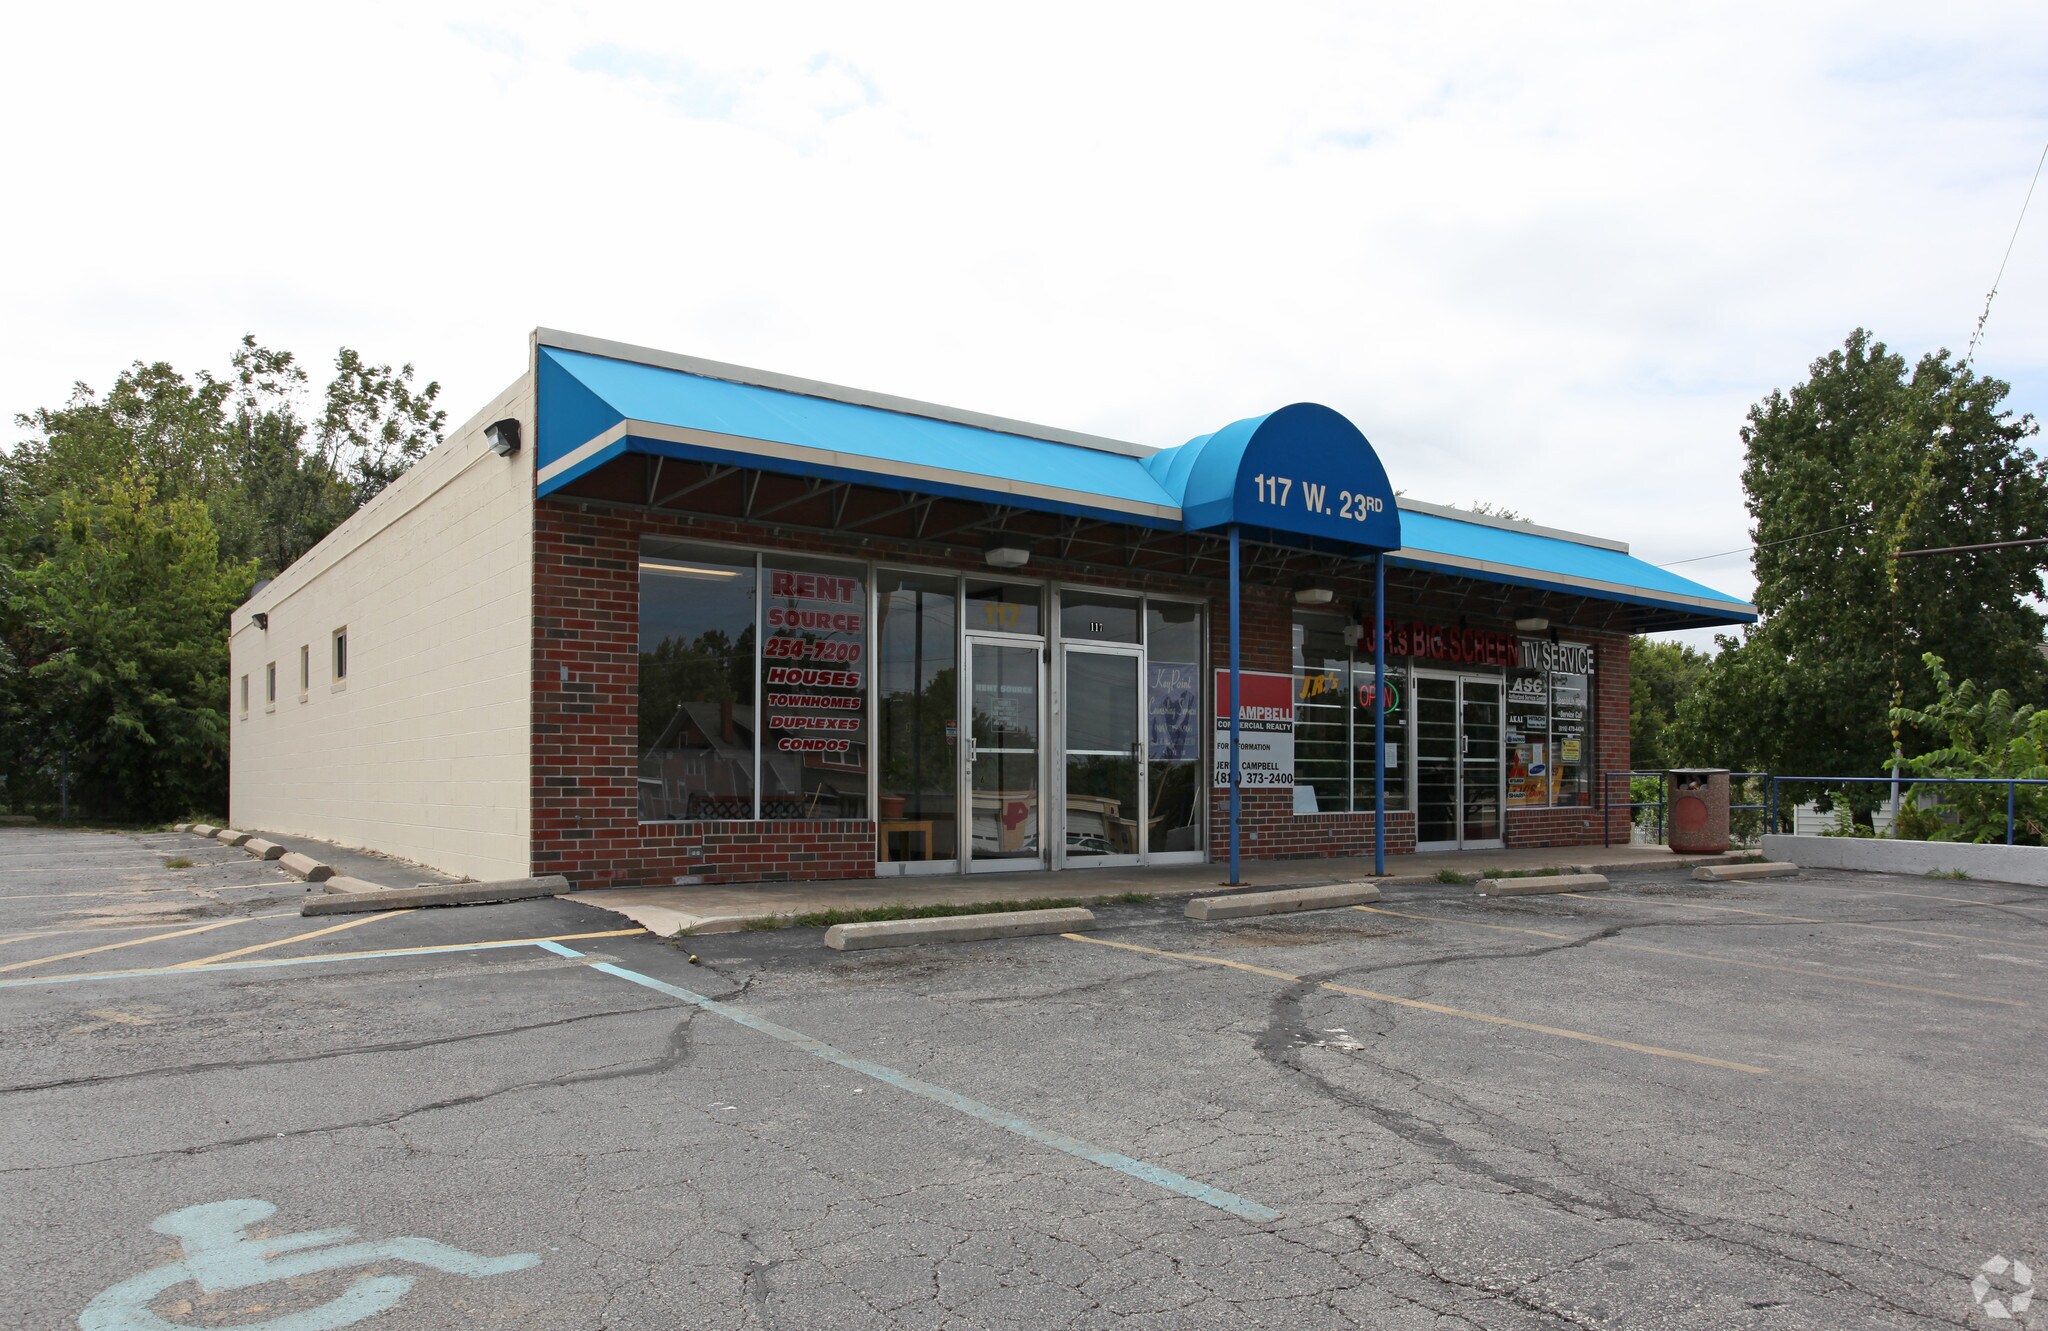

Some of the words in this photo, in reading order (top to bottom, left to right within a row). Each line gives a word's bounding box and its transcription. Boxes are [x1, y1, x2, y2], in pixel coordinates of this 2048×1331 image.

[1254, 473, 1292, 507] 117
[1302, 481, 1332, 516] W.
[771, 570, 857, 604] RENT
[767, 606, 862, 634] SOURCE
[983, 602, 1021, 627] 117
[1090, 622, 1104, 632] 117
[763, 637, 862, 664] 254-7200
[1413, 625, 1445, 657] BIG
[1448, 628, 1518, 667] SCREEN
[1522, 641, 1538, 668] TV
[1542, 643, 1594, 674] SERVICE
[767, 667, 861, 688] HOUSES
[769, 693, 861, 710] TOWNHOMES
[1360, 685, 1392, 708] OPN
[1233, 706, 1292, 720] AMPBELL
[769, 715, 859, 731] DUPLEXES
[1217, 720, 1264, 730] COERCIAL
[1266, 723, 1292, 731] REALTY
[778, 738, 850, 752] CONDOS
[1217, 742, 1229, 750] FOR
[1216, 761, 1238, 770] JER
[1241, 762, 1279, 771] CAMPBELL
[1214, 771, 1242, 785] (81)
[1246, 772, 1293, 784] 373-2400
